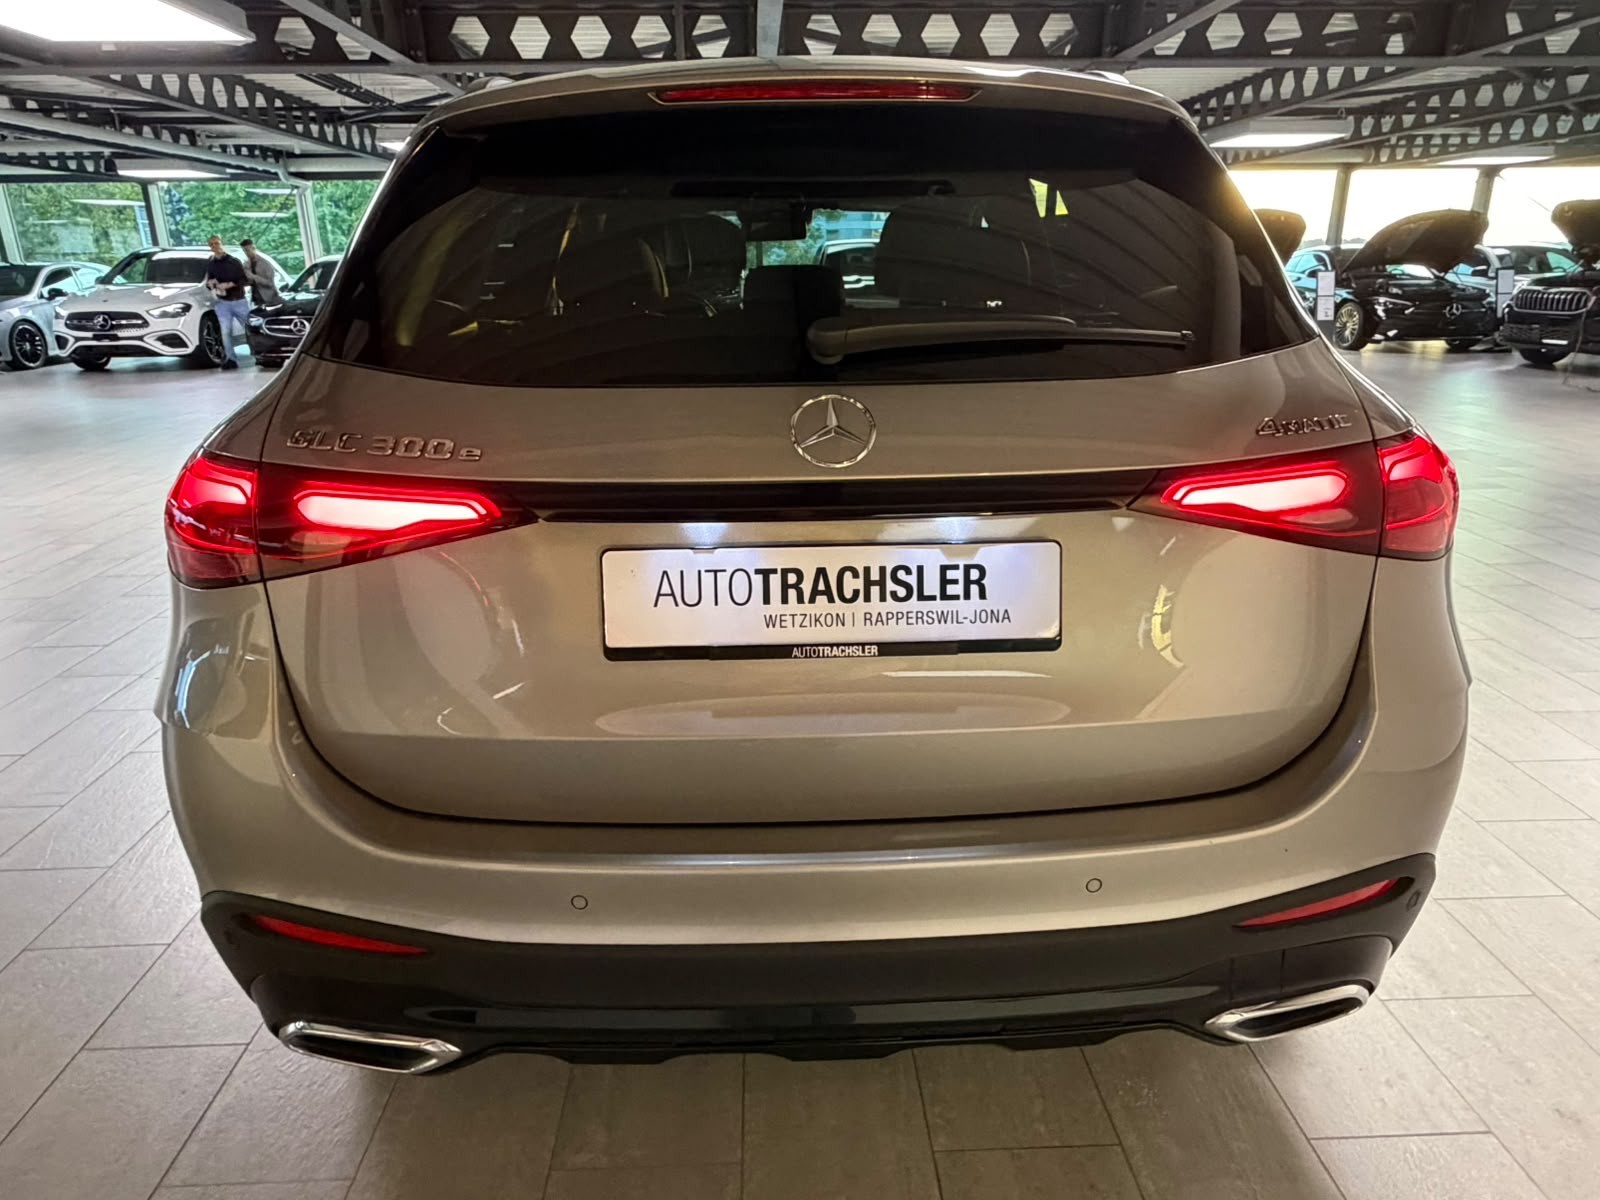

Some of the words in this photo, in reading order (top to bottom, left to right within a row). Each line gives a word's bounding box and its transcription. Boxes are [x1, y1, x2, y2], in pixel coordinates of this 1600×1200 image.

[286, 429, 363, 453] GLC
[763, 612, 846, 630] WETZIKON
[862, 609, 1012, 627] RAPPERSWIL-JONA
[791, 645, 879, 658] AUTOTRACHSLER
